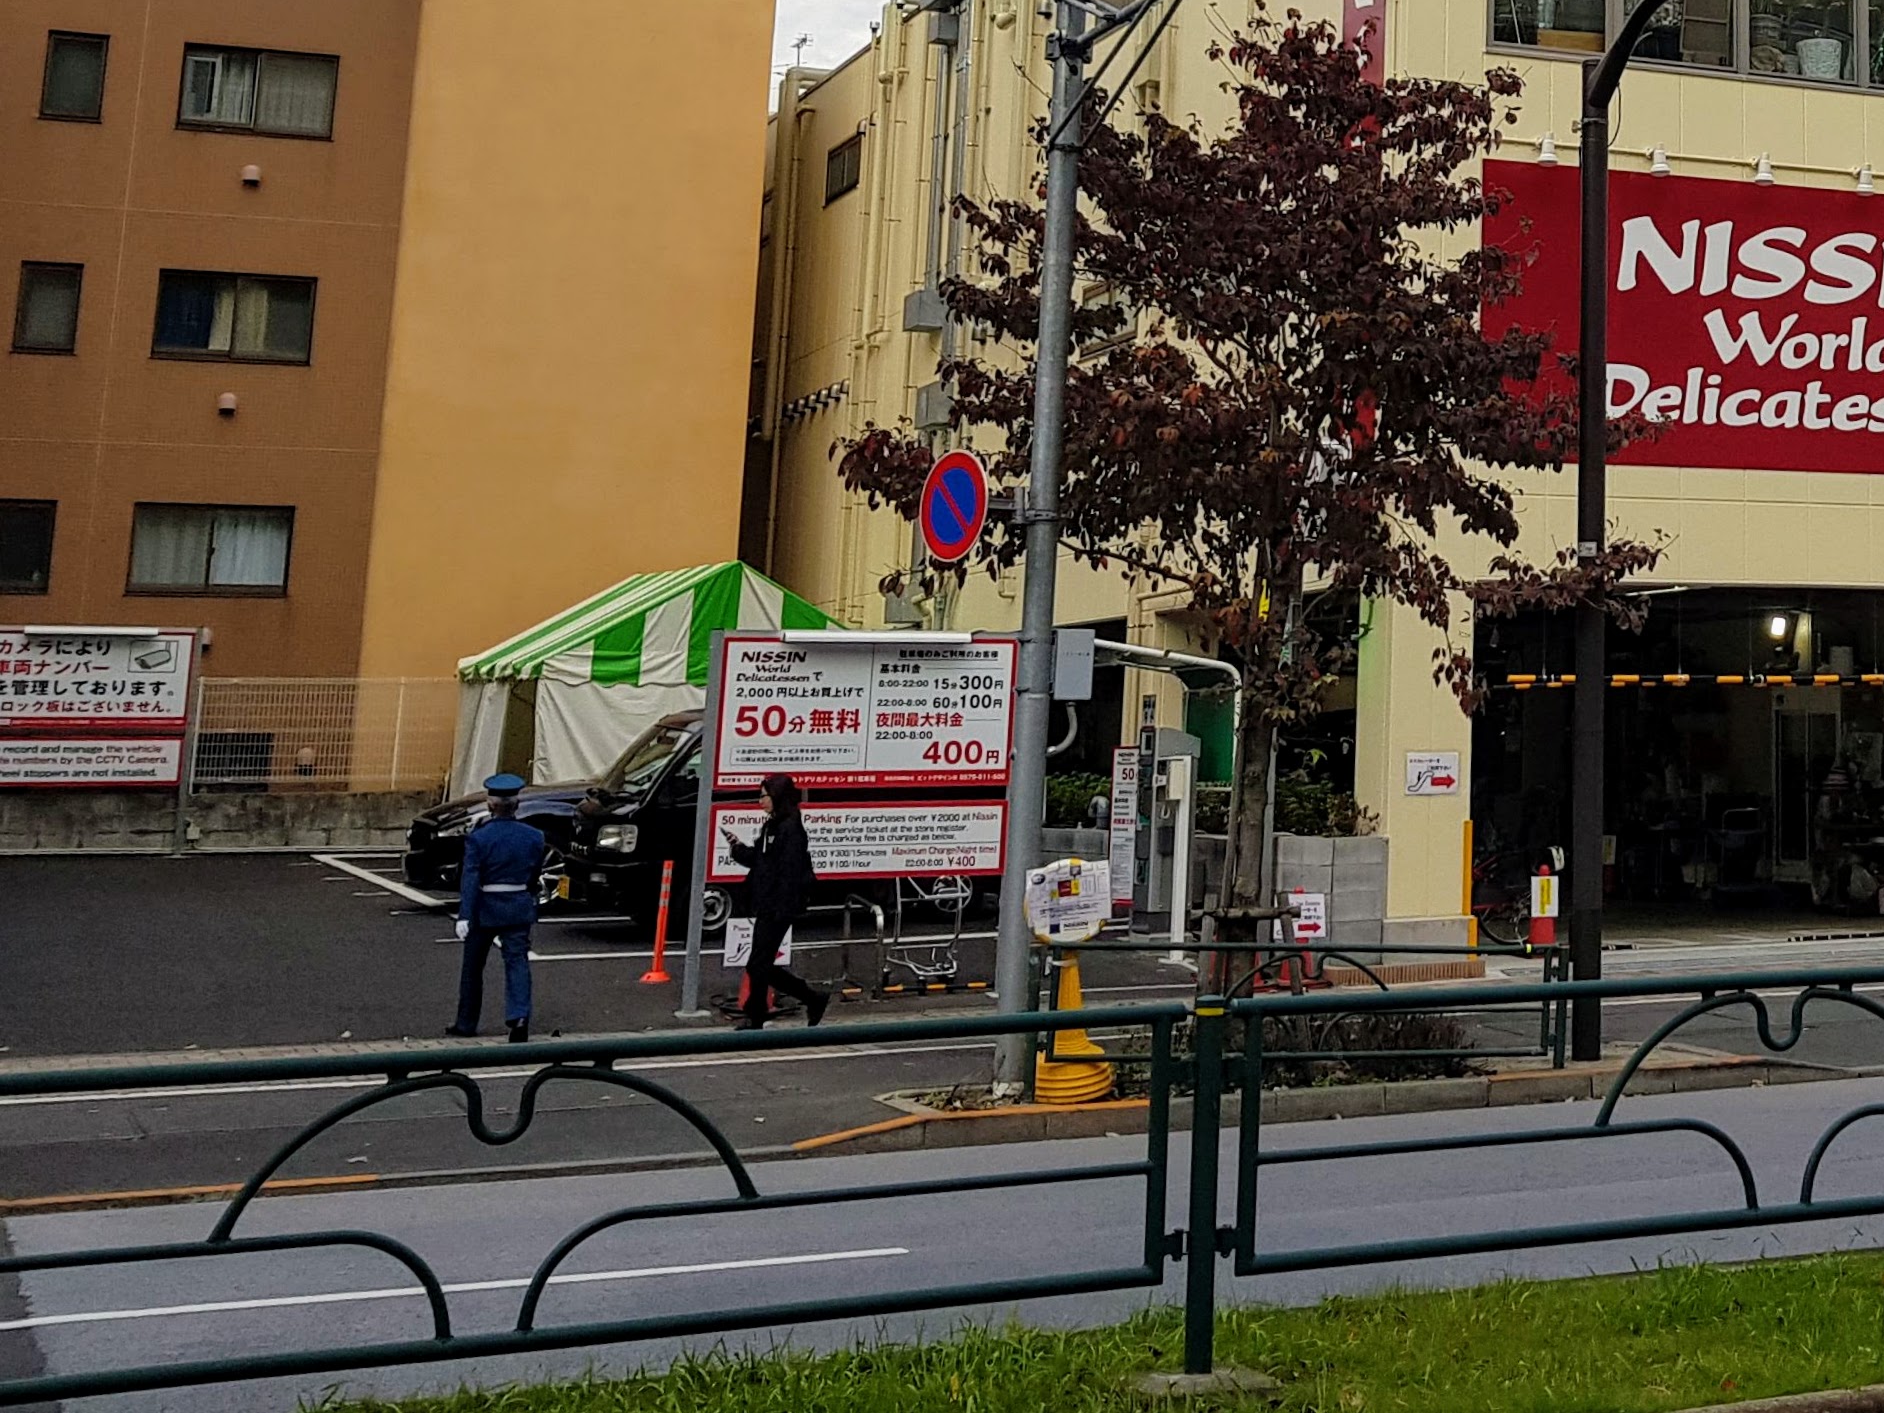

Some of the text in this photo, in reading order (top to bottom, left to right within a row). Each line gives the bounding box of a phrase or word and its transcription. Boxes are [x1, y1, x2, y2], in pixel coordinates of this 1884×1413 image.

[741, 651, 807, 663] NISSIN
[755, 664, 791, 673] World
[879, 663, 921, 674] 基本料金
[876, 712, 964, 728] 夜間最大料金
[875, 731, 933, 740] 22:00-8:00
[95, 756, 124, 764] CCTV
[722, 815, 735, 825] 50
[804, 814, 841, 825] Parking
[845, 814, 860, 824] For
[861, 814, 906, 824] purchases
[908, 814, 928, 822] over
[962, 813, 970, 821] at
[972, 812, 998, 821] Nissin
[820, 827, 833, 835] the
[835, 826, 863, 835] service
